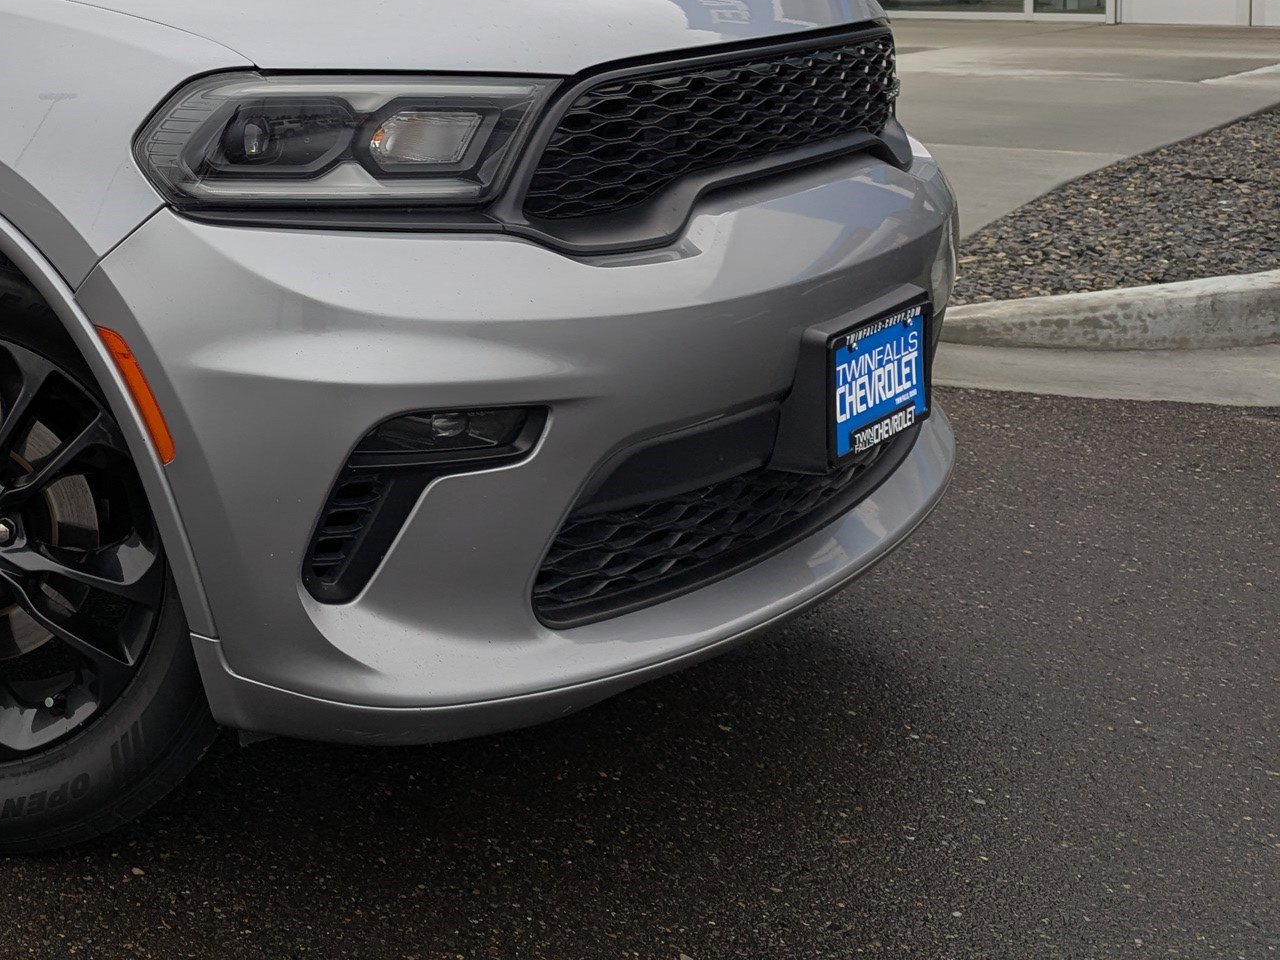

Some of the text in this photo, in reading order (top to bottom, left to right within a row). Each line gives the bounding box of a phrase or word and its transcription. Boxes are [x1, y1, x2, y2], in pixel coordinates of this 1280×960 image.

[836, 351, 918, 423] CHEVROLET
[854, 426, 874, 448] TWIN
[873, 405, 916, 444] CHEVROLET
[854, 437, 875, 454] FALLS
[0, 772, 91, 821] OPEN
